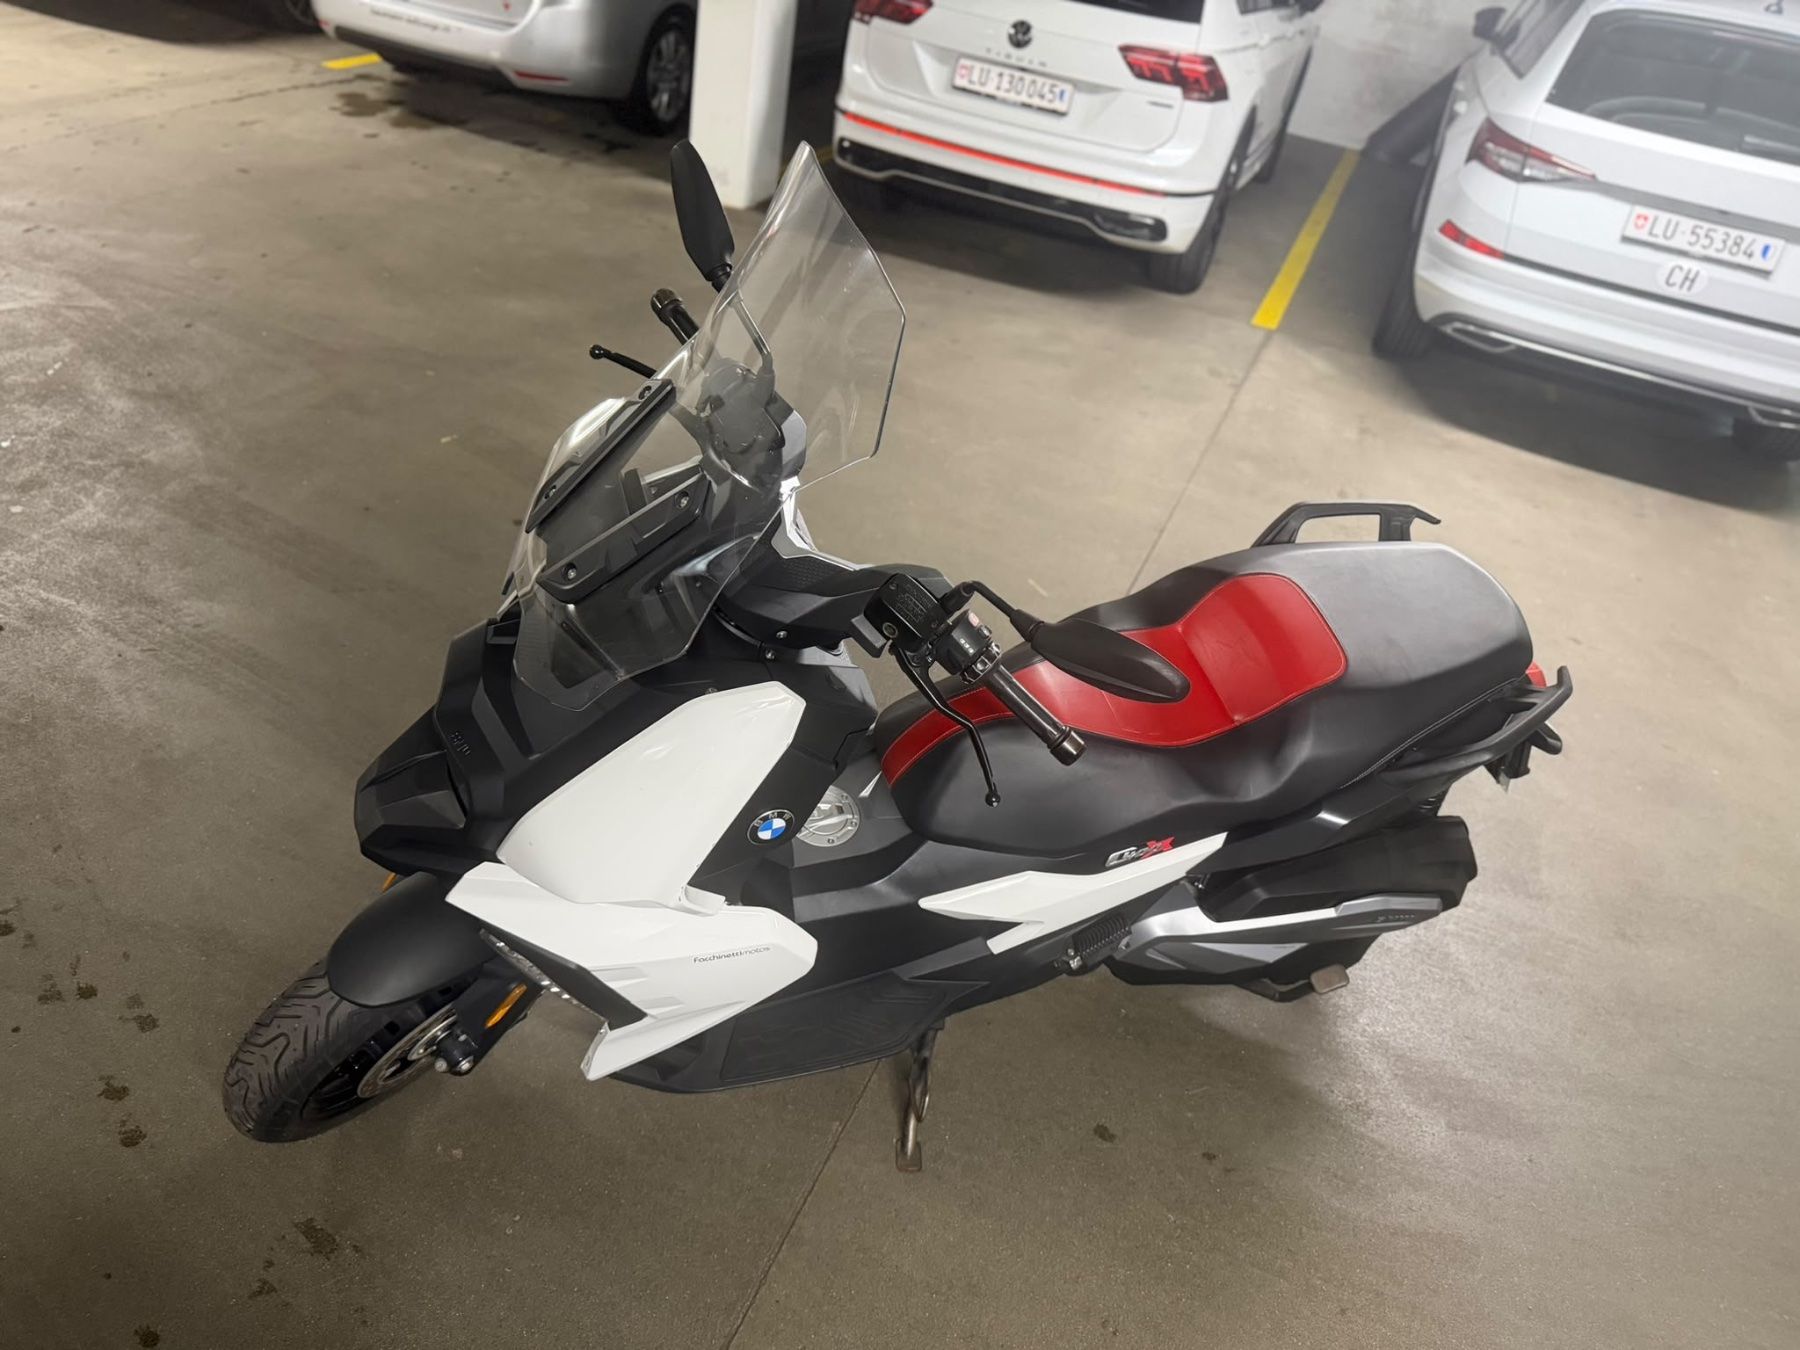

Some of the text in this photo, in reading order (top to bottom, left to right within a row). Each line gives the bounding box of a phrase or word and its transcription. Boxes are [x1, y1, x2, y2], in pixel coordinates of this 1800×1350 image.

[968, 64, 1058, 103] LU 130045
[1648, 214, 1756, 259] LU 55384
[1664, 264, 1700, 293] CH
